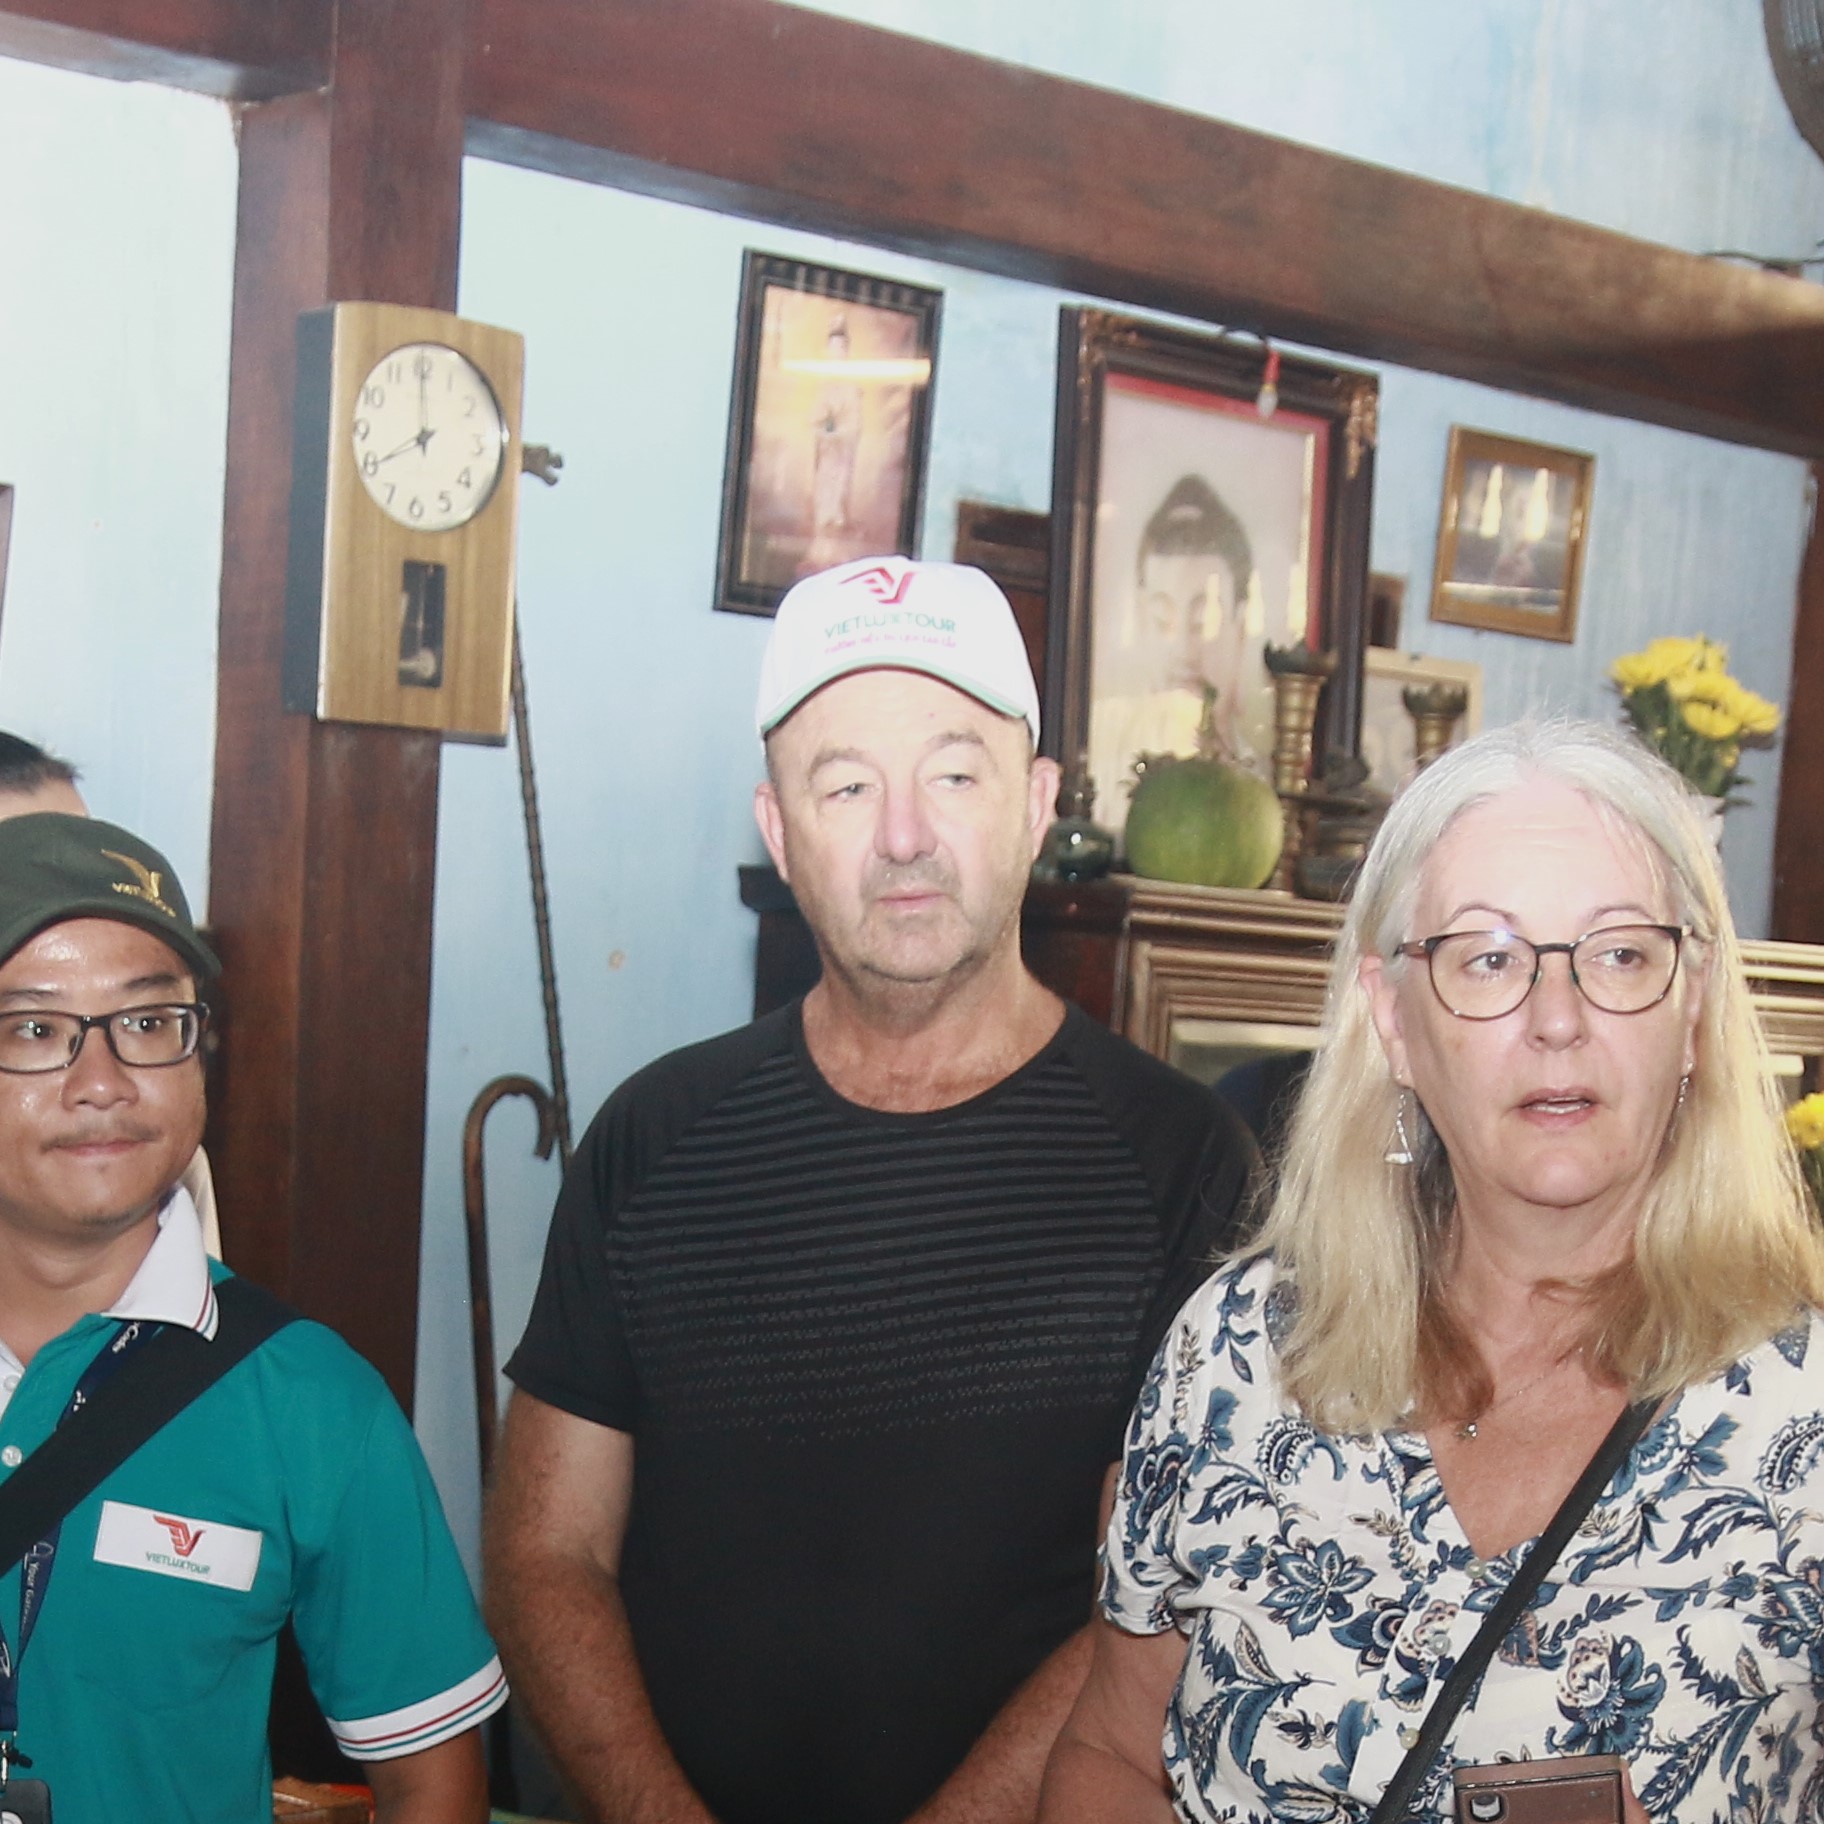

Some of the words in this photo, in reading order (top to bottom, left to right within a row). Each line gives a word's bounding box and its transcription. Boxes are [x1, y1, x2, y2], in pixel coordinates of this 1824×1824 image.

[363, 384, 385, 409] 10
[354, 418, 371, 441] 9
[472, 432, 485, 457] 3
[363, 451, 379, 477] 8
[456, 466, 473, 490] 4
[383, 482, 397, 505] 7
[438, 489, 452, 513] 5
[408, 496, 424, 520] 6
